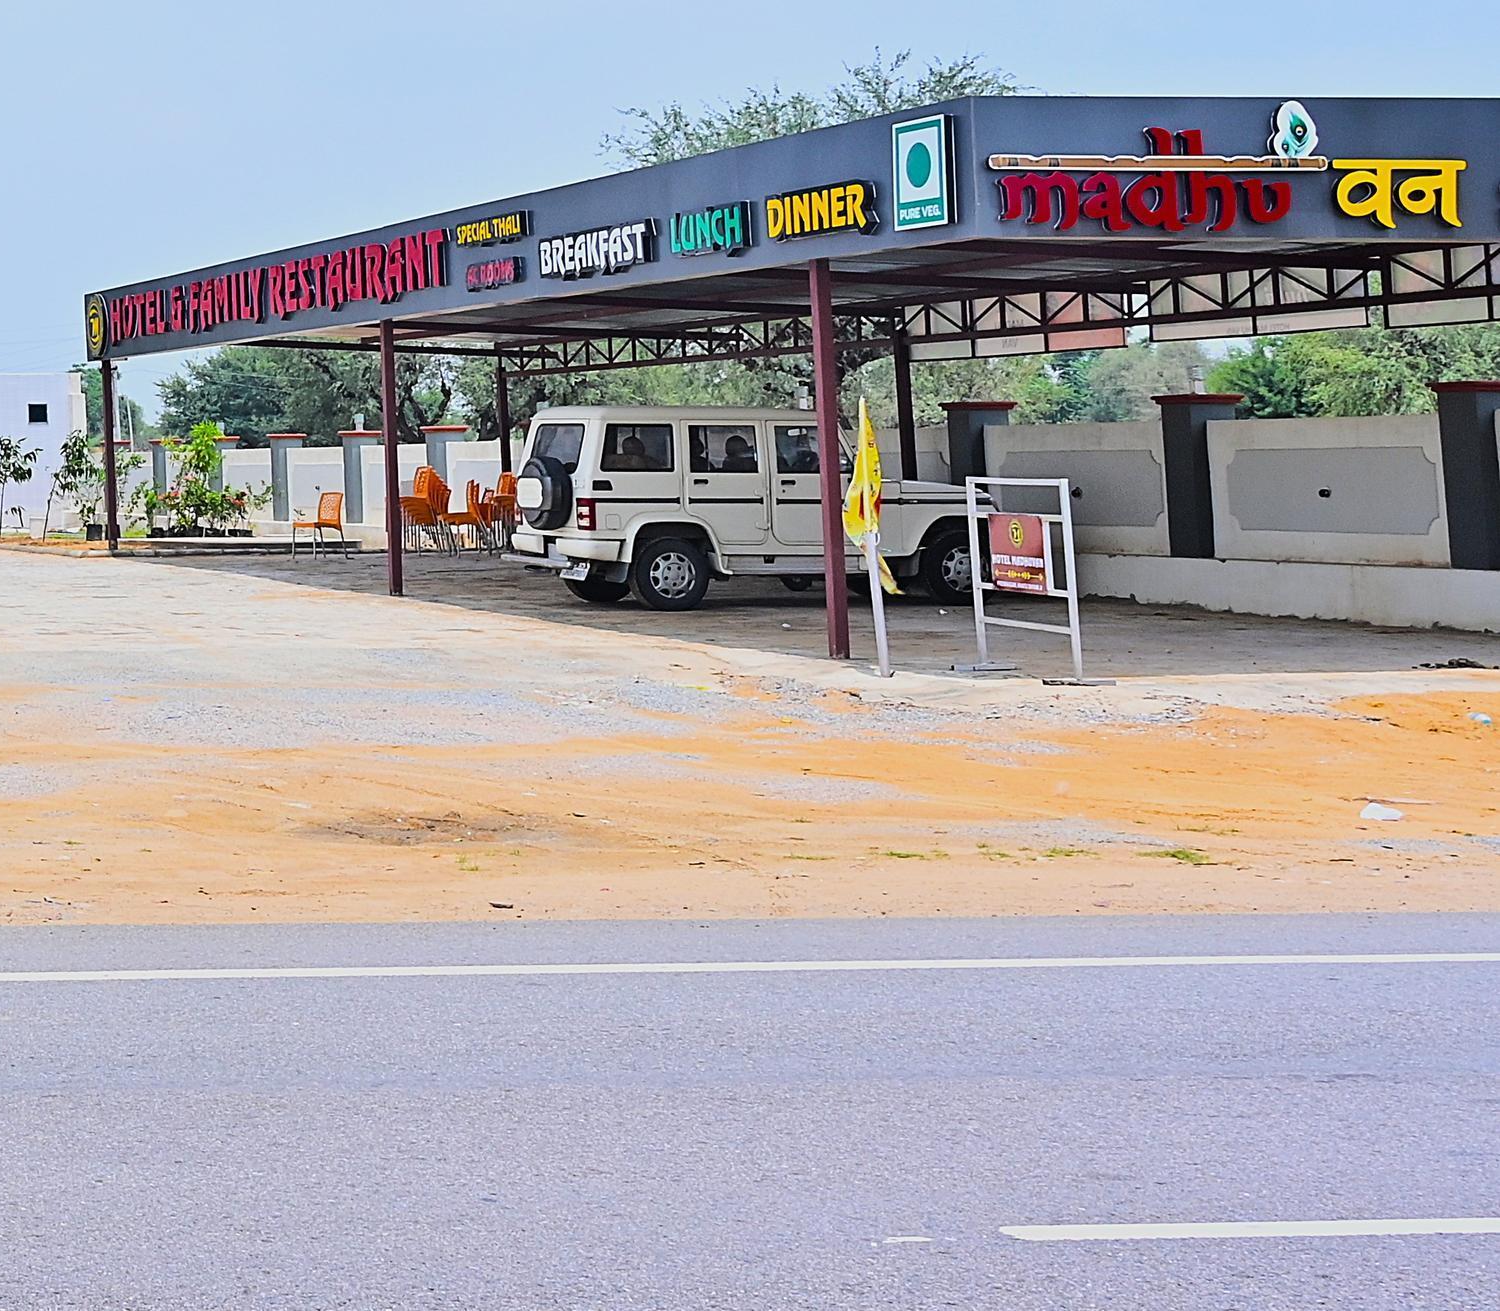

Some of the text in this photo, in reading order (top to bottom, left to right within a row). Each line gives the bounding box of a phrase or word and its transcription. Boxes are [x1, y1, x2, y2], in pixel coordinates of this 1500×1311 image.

[999, 126, 1292, 232] madhu
[1332, 159, 1468, 229] वन
[456, 214, 521, 245] SPECIAL THALI
[669, 204, 745, 255] LUNCH
[766, 183, 868, 240] DINNER
[899, 204, 942, 221] PURE VEG.
[539, 222, 649, 278] BREAKFAST
[109, 289, 167, 346] HOTEL
[170, 285, 187, 332] &
[188, 267, 266, 335] FAMILY
[269, 228, 447, 320] RESTAURANT
